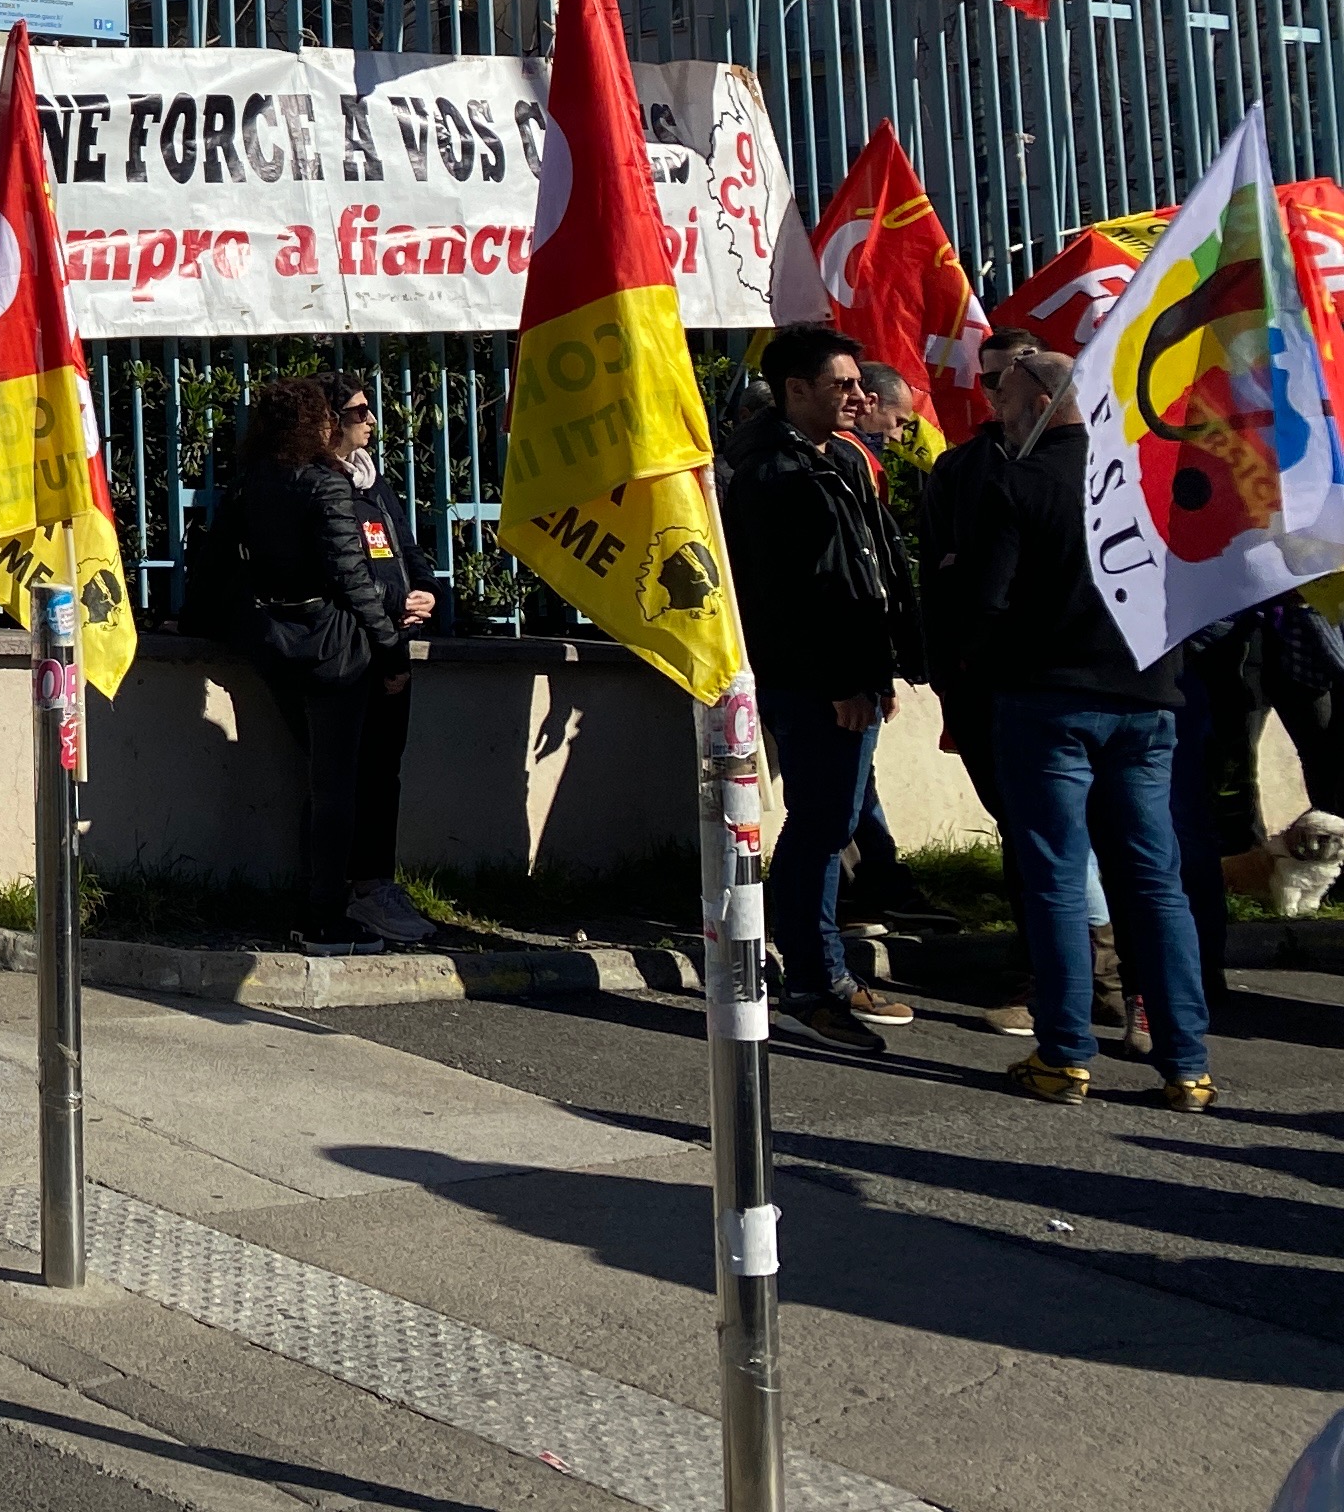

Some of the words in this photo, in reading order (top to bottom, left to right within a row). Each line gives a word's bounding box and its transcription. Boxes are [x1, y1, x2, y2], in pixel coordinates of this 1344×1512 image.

[125, 91, 325, 185] FORCE
[338, 93, 385, 182] A
[387, 95, 506, 183] VOS
[275, 224, 319, 277] a
[337, 204, 535, 277] fiancu
